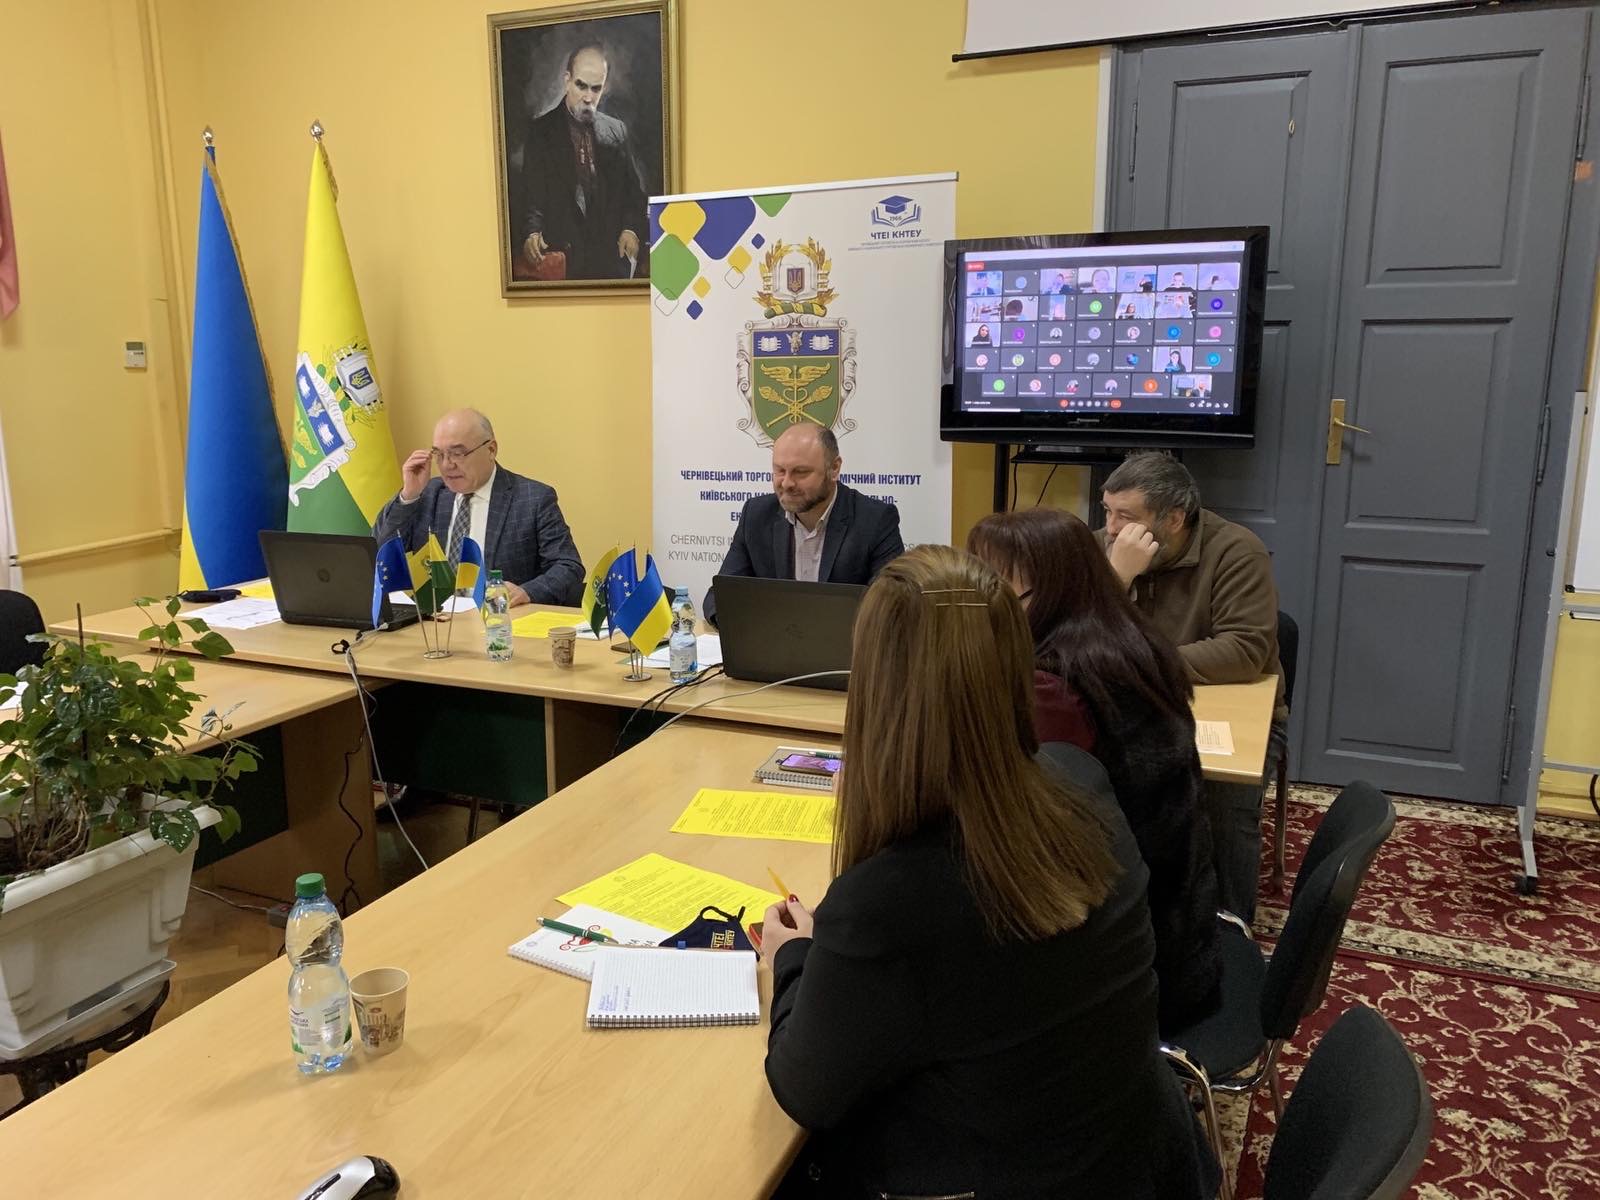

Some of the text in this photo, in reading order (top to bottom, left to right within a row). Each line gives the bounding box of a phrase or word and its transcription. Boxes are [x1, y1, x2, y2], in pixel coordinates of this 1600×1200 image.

[870, 229, 922, 240] ЧТЕІ КНТЕУ
[680, 470, 743, 482] ЧЕРНІВЕЦЬКИЙ
[878, 474, 921, 486] ІНСТИТУТ
[700, 489, 752, 502] КИЇВСЬКОГО
[670, 534, 725, 546] CHERNIVTSI
[668, 551, 725, 563] KYIV NATION
